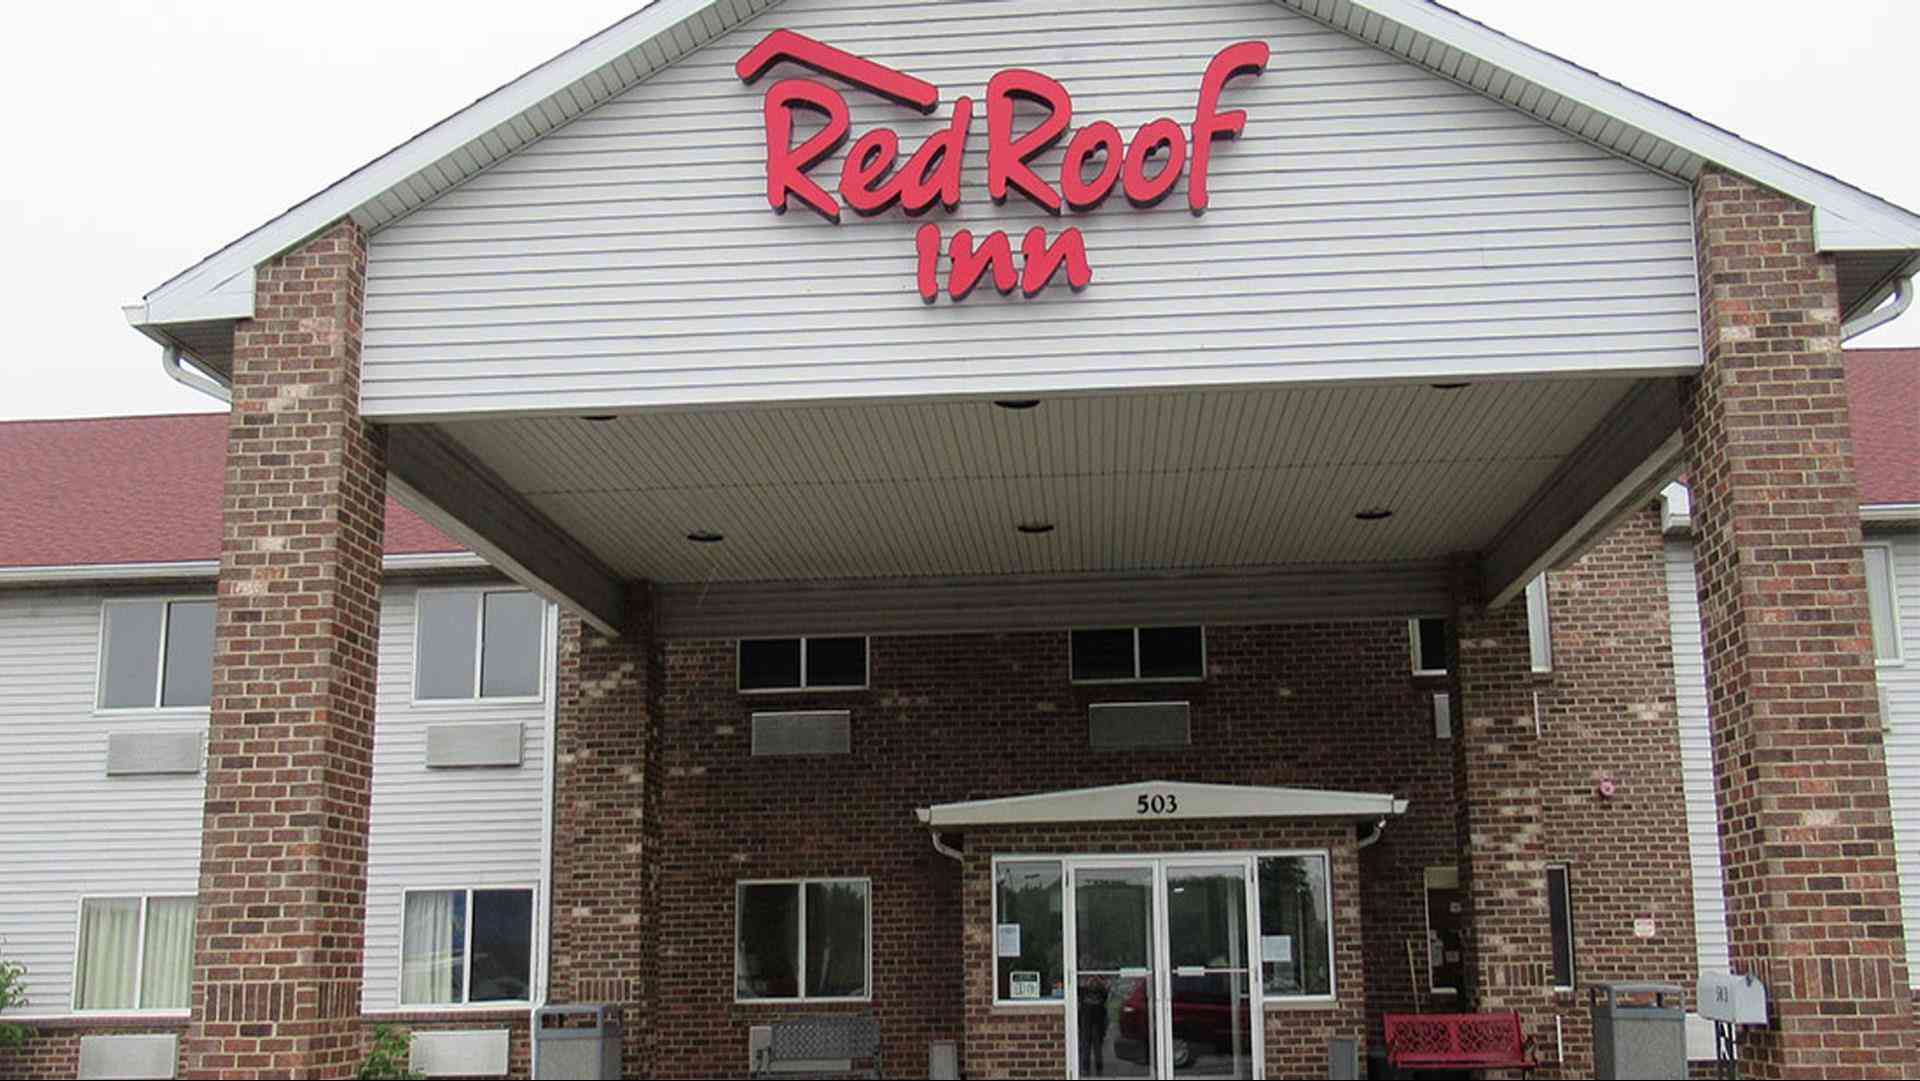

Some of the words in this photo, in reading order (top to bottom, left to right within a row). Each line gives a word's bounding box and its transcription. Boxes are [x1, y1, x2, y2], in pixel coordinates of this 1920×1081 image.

[764, 79, 974, 225] Red
[986, 41, 1270, 216] Roof
[1137, 794, 1178, 814] 503
